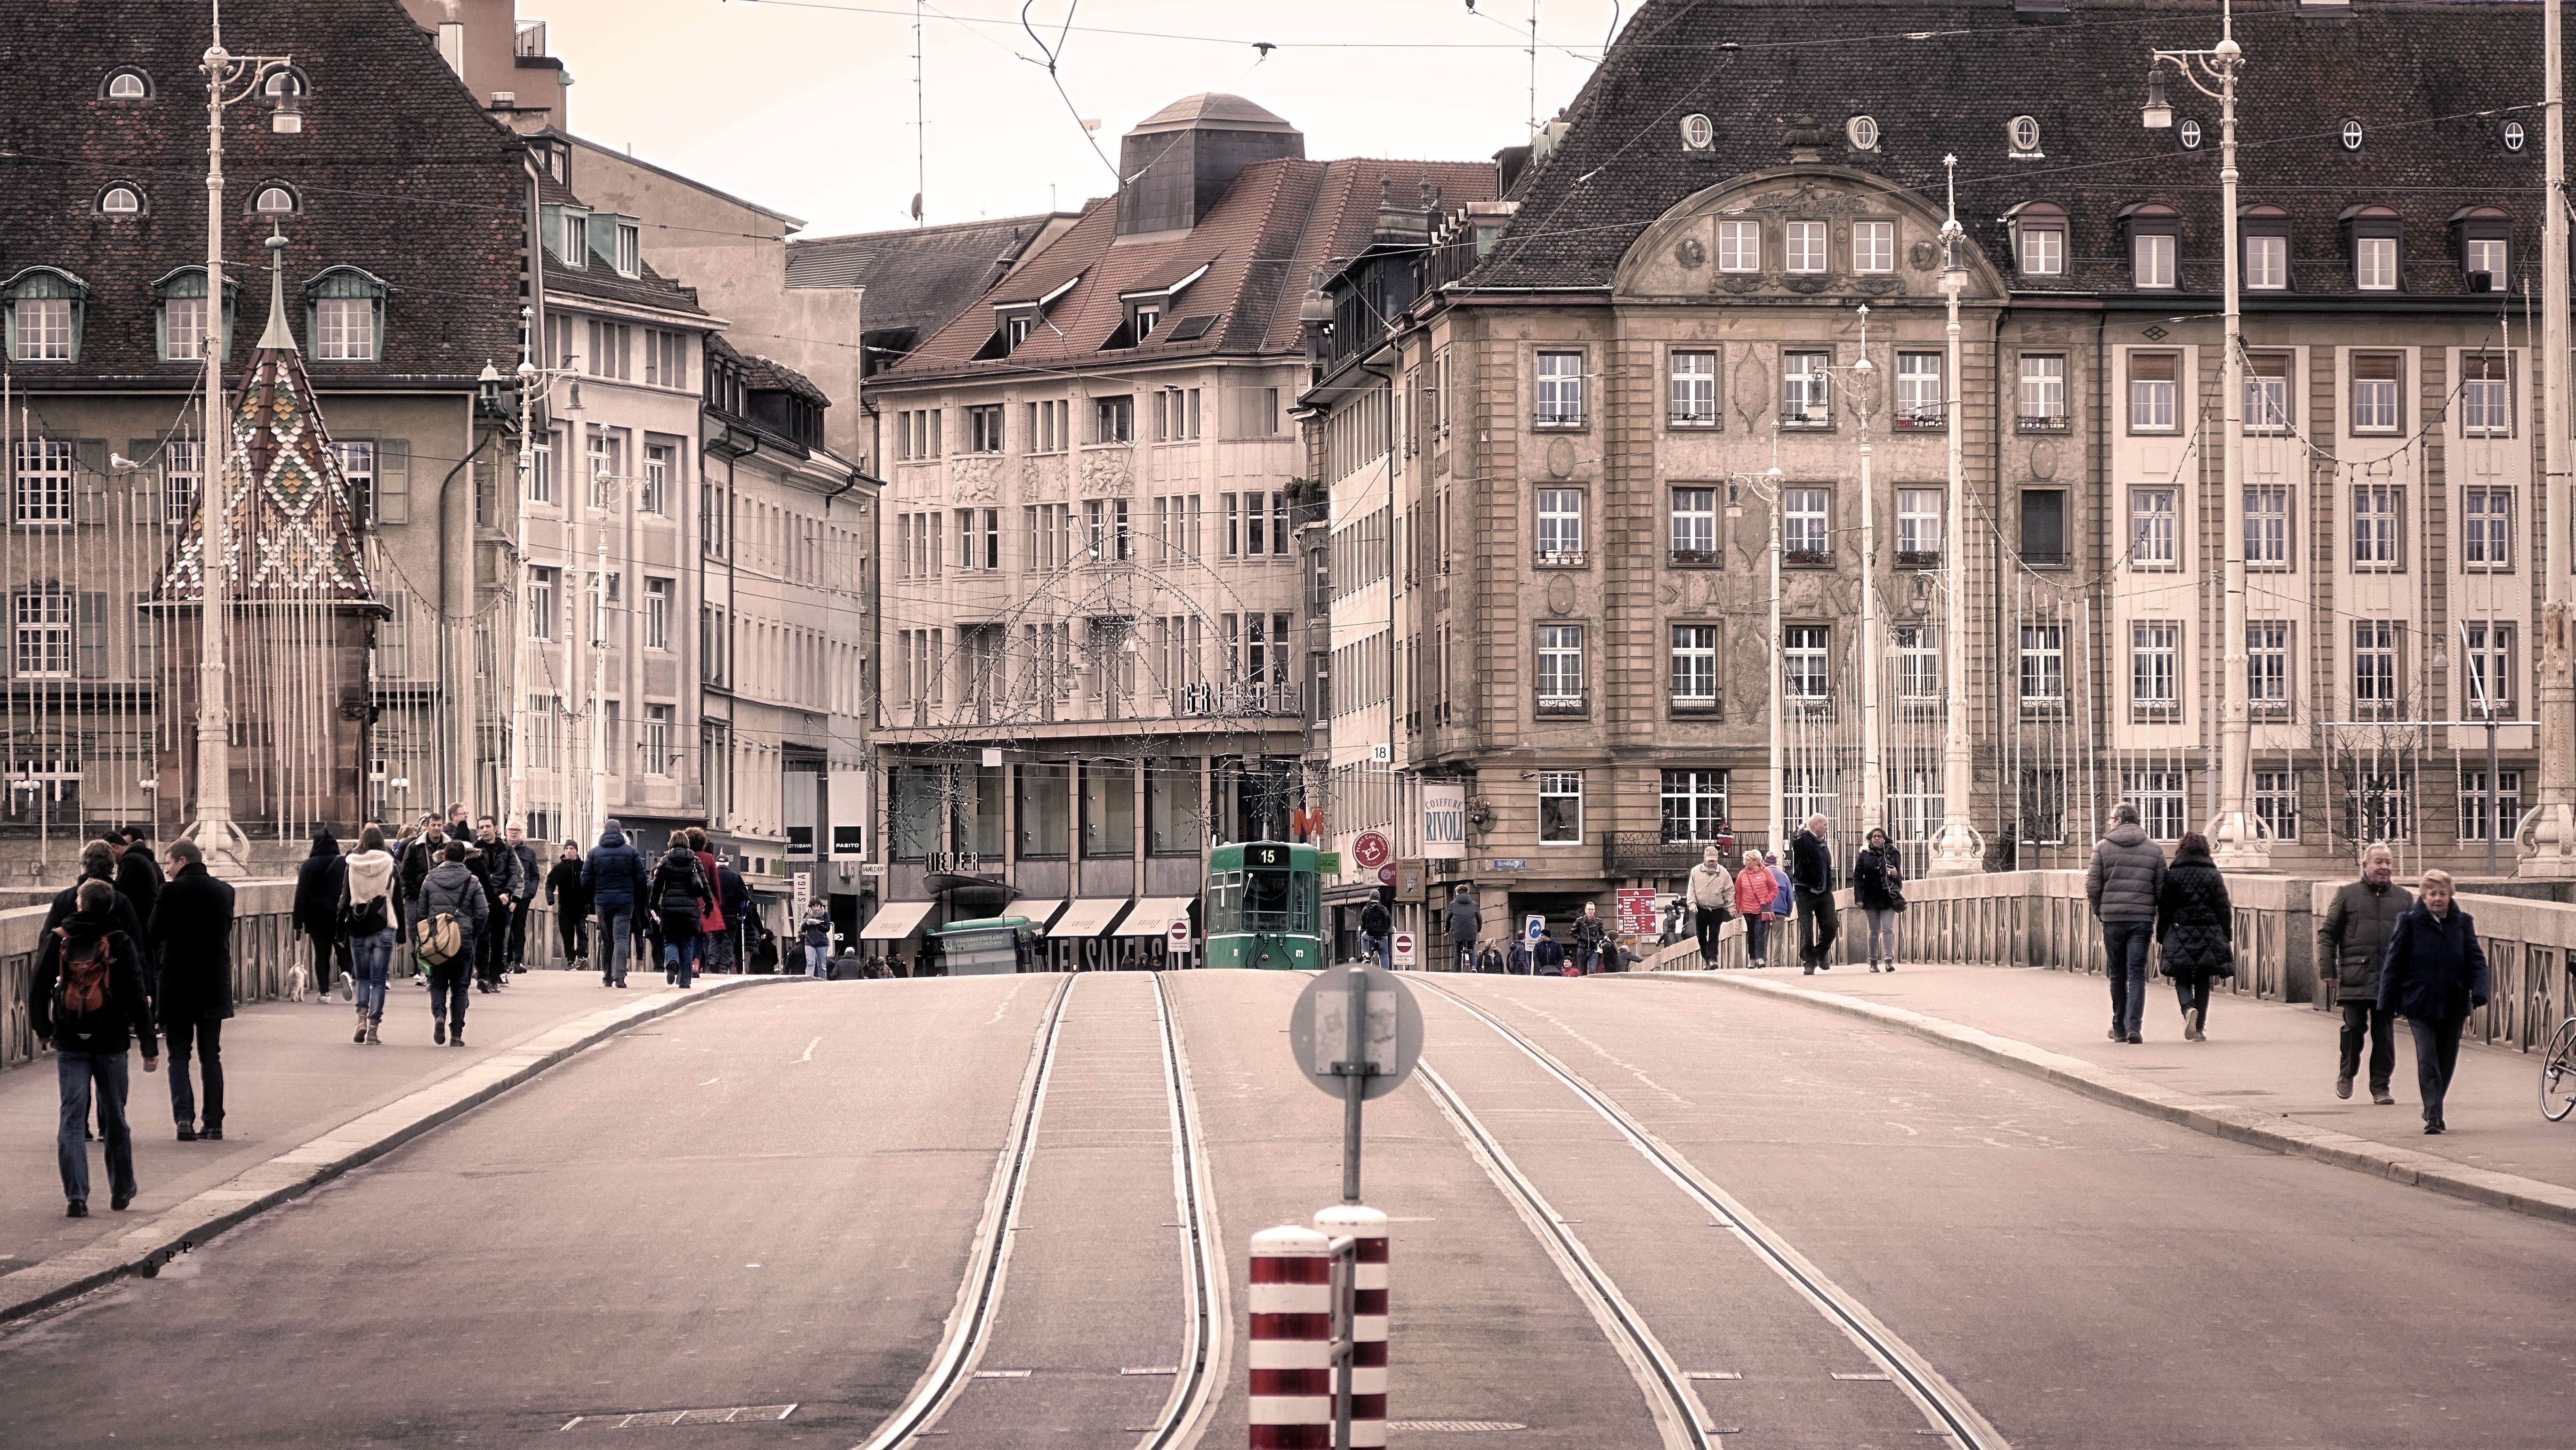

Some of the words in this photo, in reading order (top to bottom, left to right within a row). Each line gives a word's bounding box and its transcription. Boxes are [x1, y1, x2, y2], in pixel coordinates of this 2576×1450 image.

[1375, 747, 1386, 758] 18
[1425, 798, 1463, 809] COIFFURE
[1294, 809, 1324, 835] M
[1425, 811, 1463, 841] RIVOLI
[925, 852, 979, 871] RIEDER
[1261, 850, 1275, 863] 15
[941, 939, 952, 951] 33
[1296, 950, 1304, 958] 673
